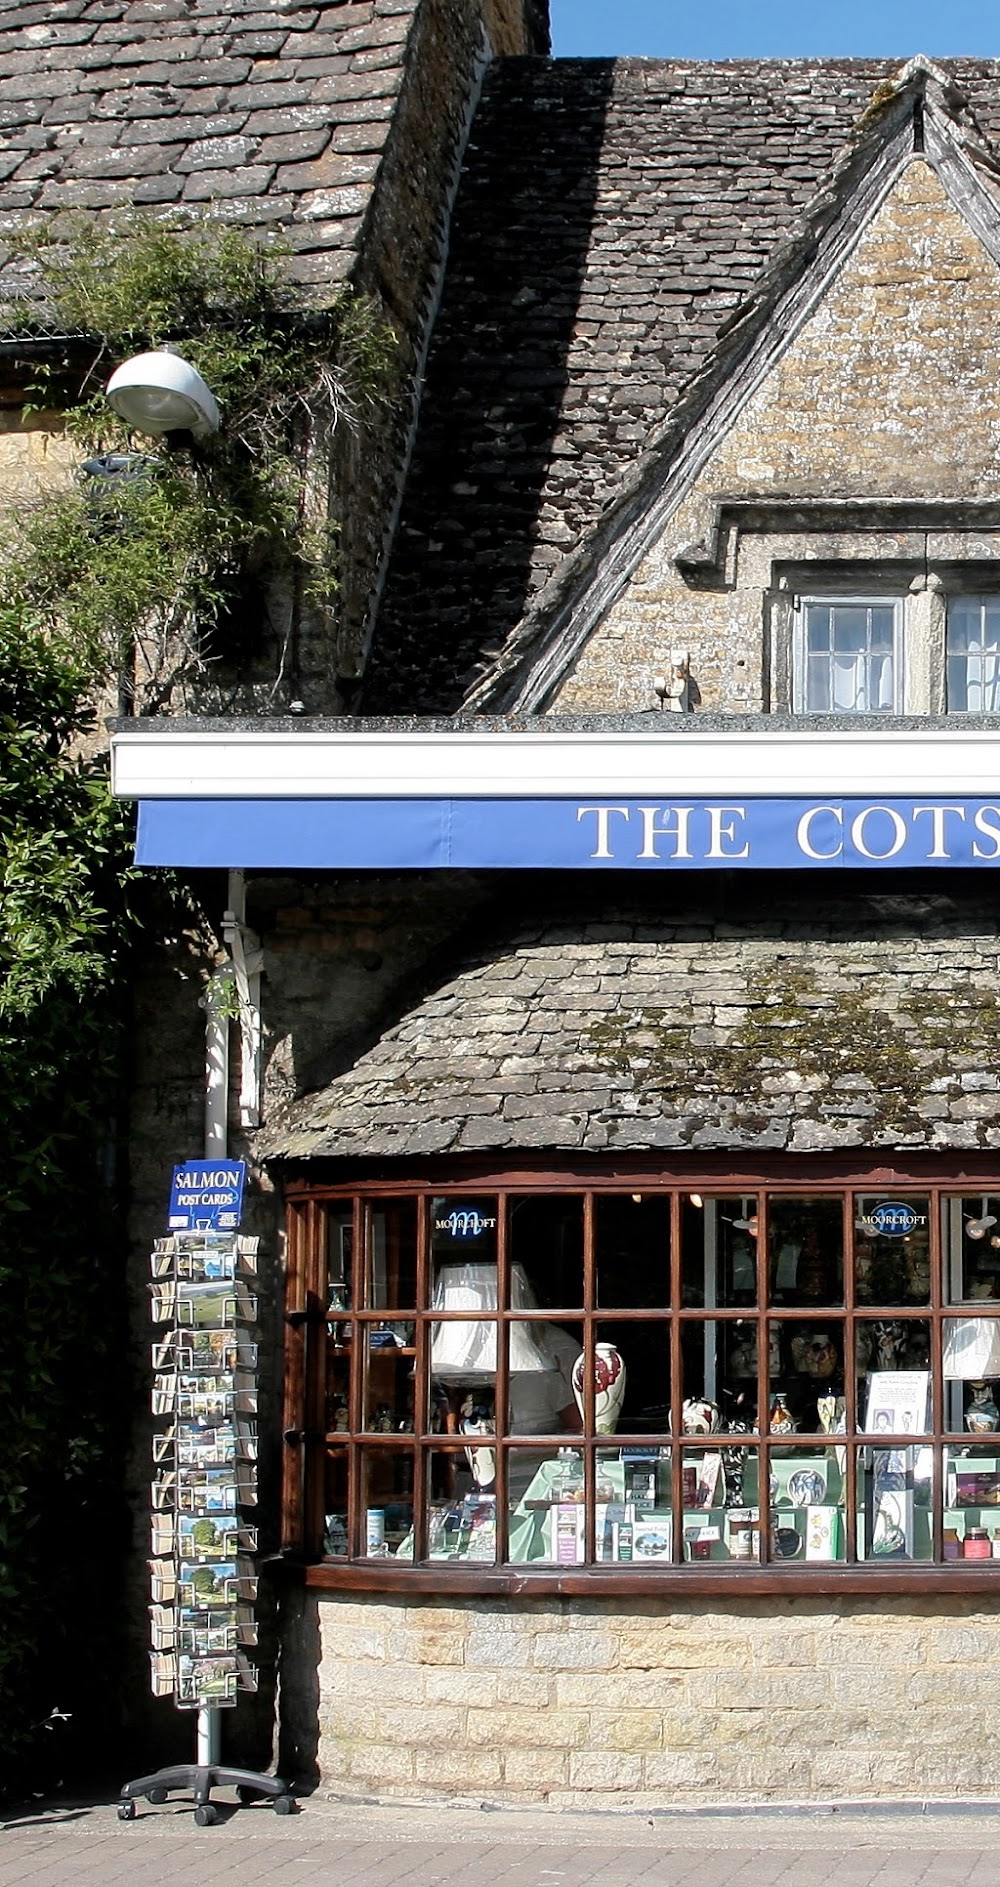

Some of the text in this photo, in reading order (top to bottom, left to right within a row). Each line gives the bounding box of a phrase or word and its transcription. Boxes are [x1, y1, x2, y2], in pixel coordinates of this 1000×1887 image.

[576, 806, 750, 859] THE
[175, 1170, 240, 1190] SALMON
[177, 1192, 234, 1206] POST CARDS
[435, 1218, 497, 1230] MOORCROFT
[861, 1215, 927, 1225] MOORCROFT
